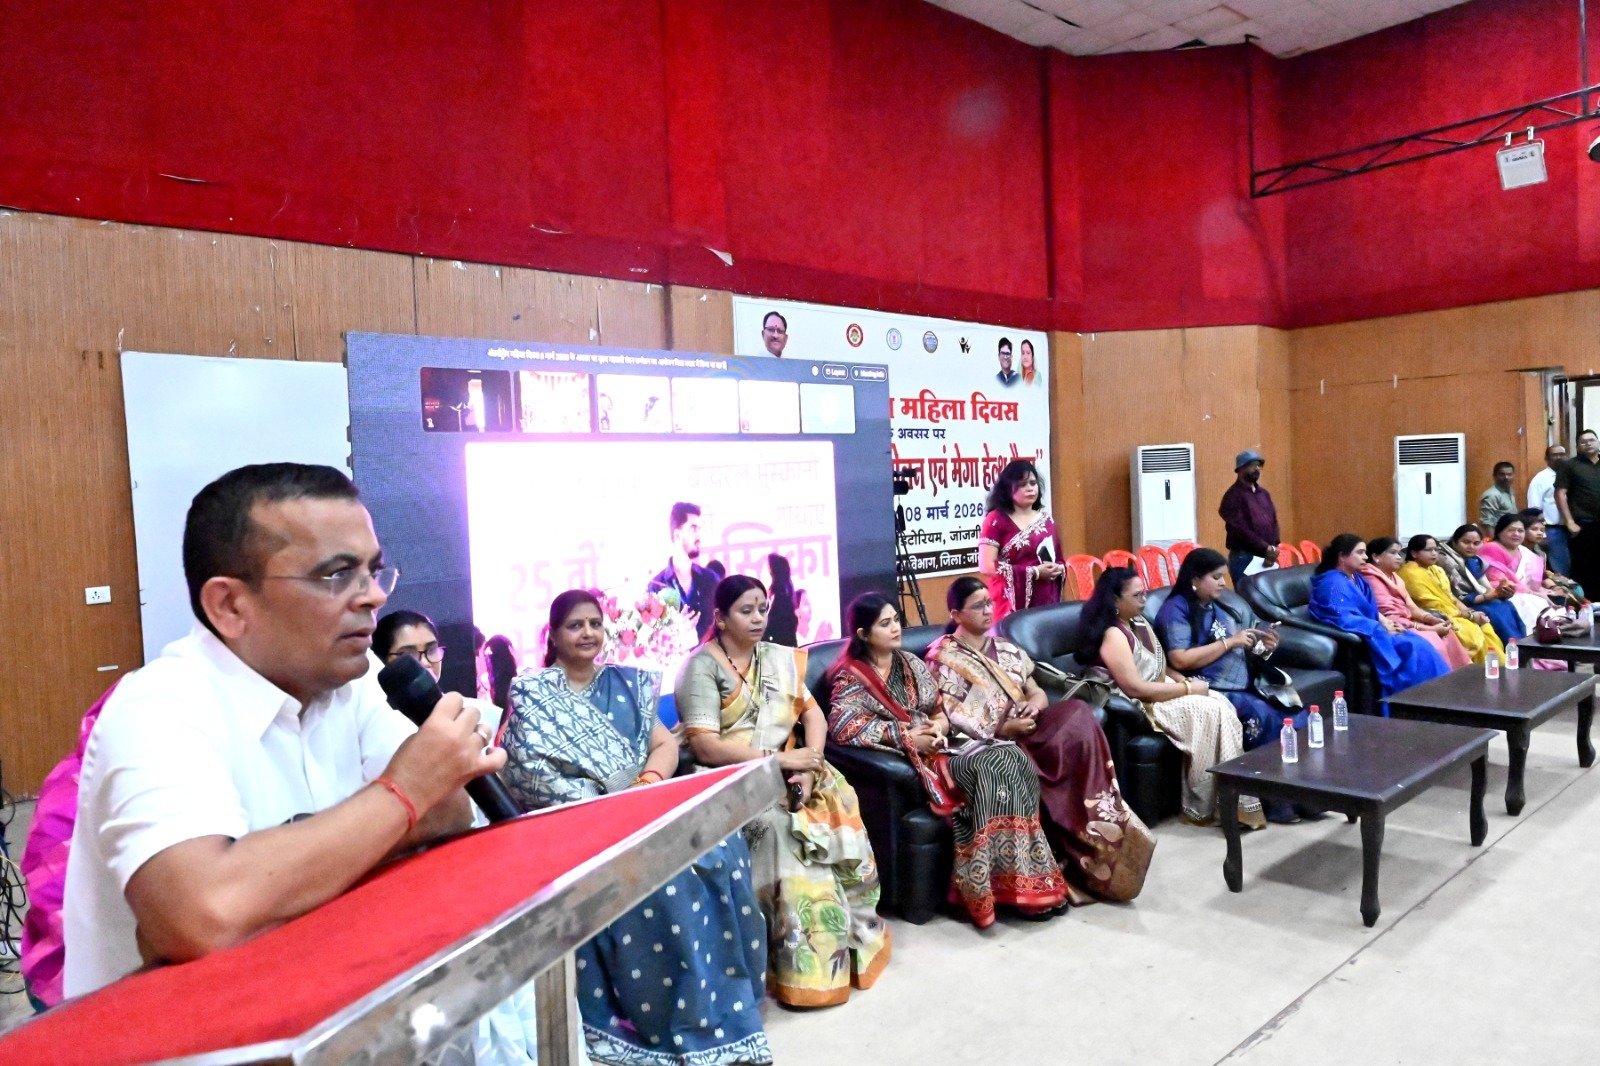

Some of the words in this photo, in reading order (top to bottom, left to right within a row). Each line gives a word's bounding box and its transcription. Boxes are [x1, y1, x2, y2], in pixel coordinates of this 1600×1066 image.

[900, 389, 965, 423] महिला
[971, 391, 1019, 423] दिवस
[898, 428, 929, 439] अवसर
[933, 428, 946, 439] पर
[928, 445, 948, 497] एवं
[951, 443, 979, 488] मेगा
[905, 507, 921, 522] 08
[926, 500, 949, 520] मार्च
[954, 503, 984, 519] 2026
